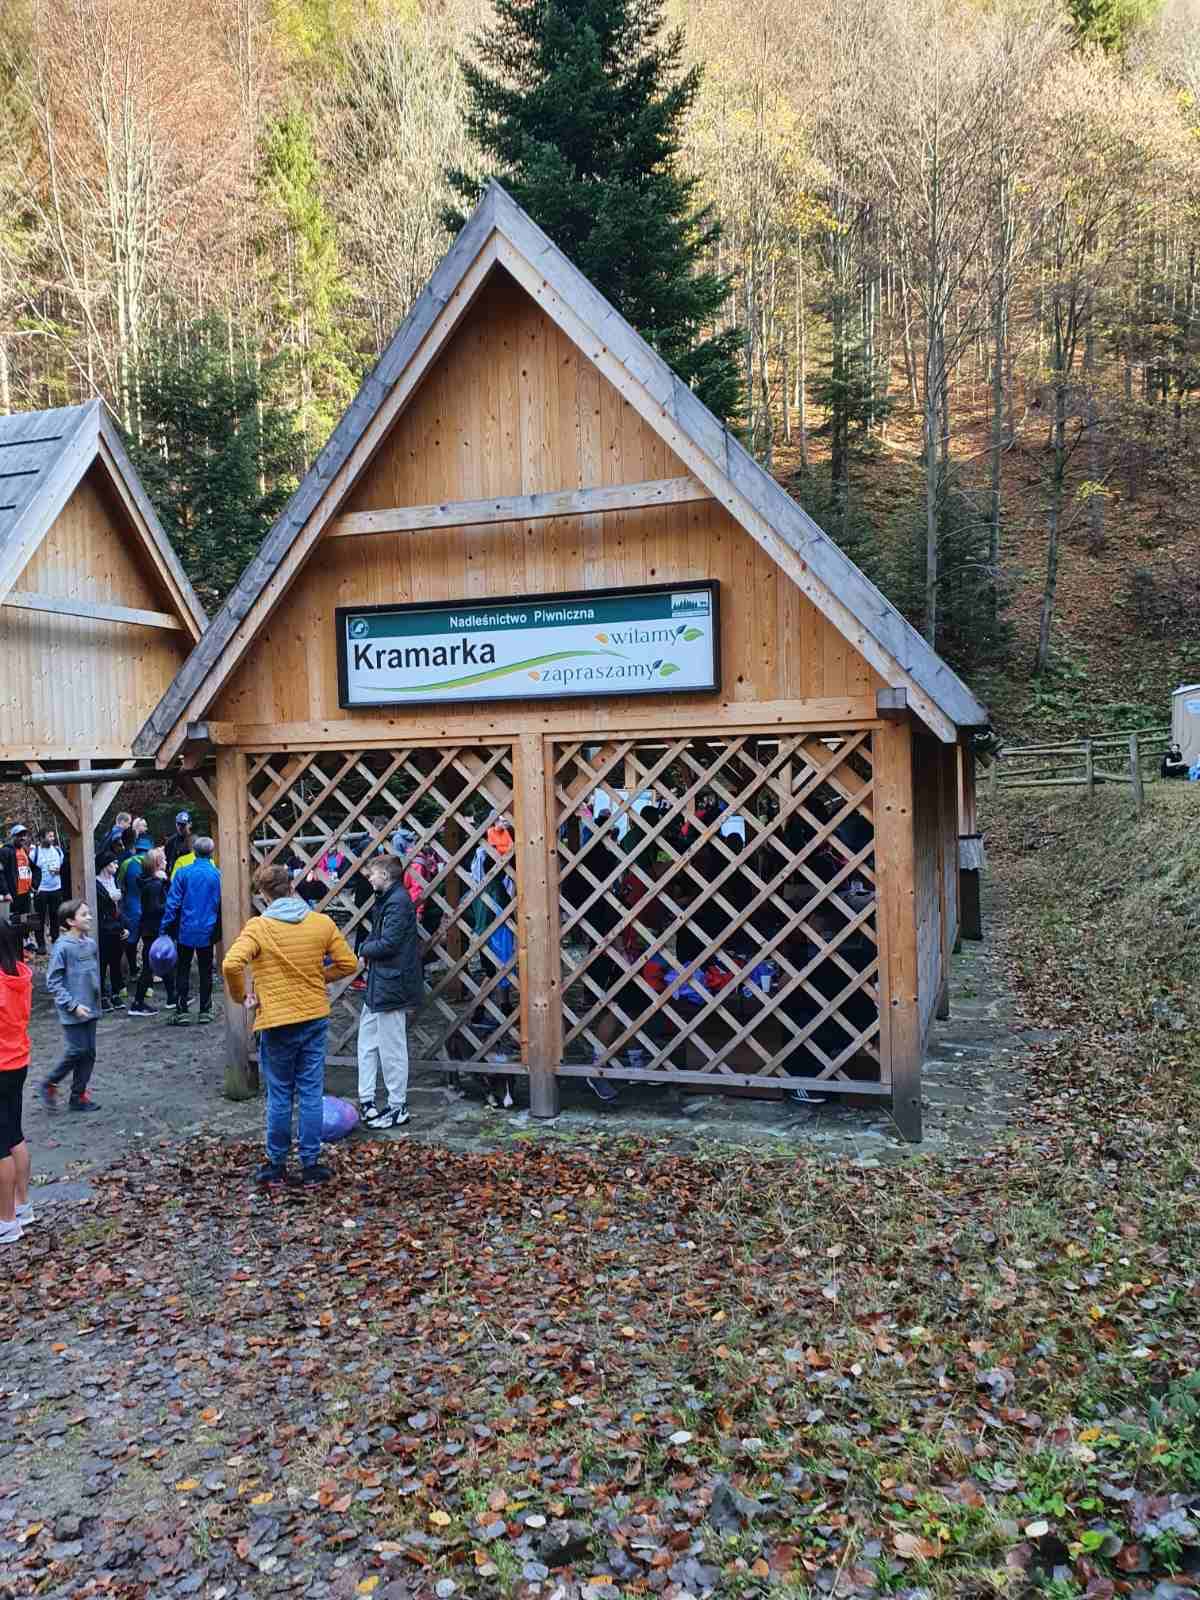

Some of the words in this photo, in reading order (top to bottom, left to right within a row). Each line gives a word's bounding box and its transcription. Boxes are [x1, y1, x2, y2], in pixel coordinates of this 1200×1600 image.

[449, 613, 527, 628] Nadleśnictwo
[534, 608, 595, 622] Piwniczna
[354, 638, 496, 670] Kramarka
[542, 663, 655, 685] zapraszamy
